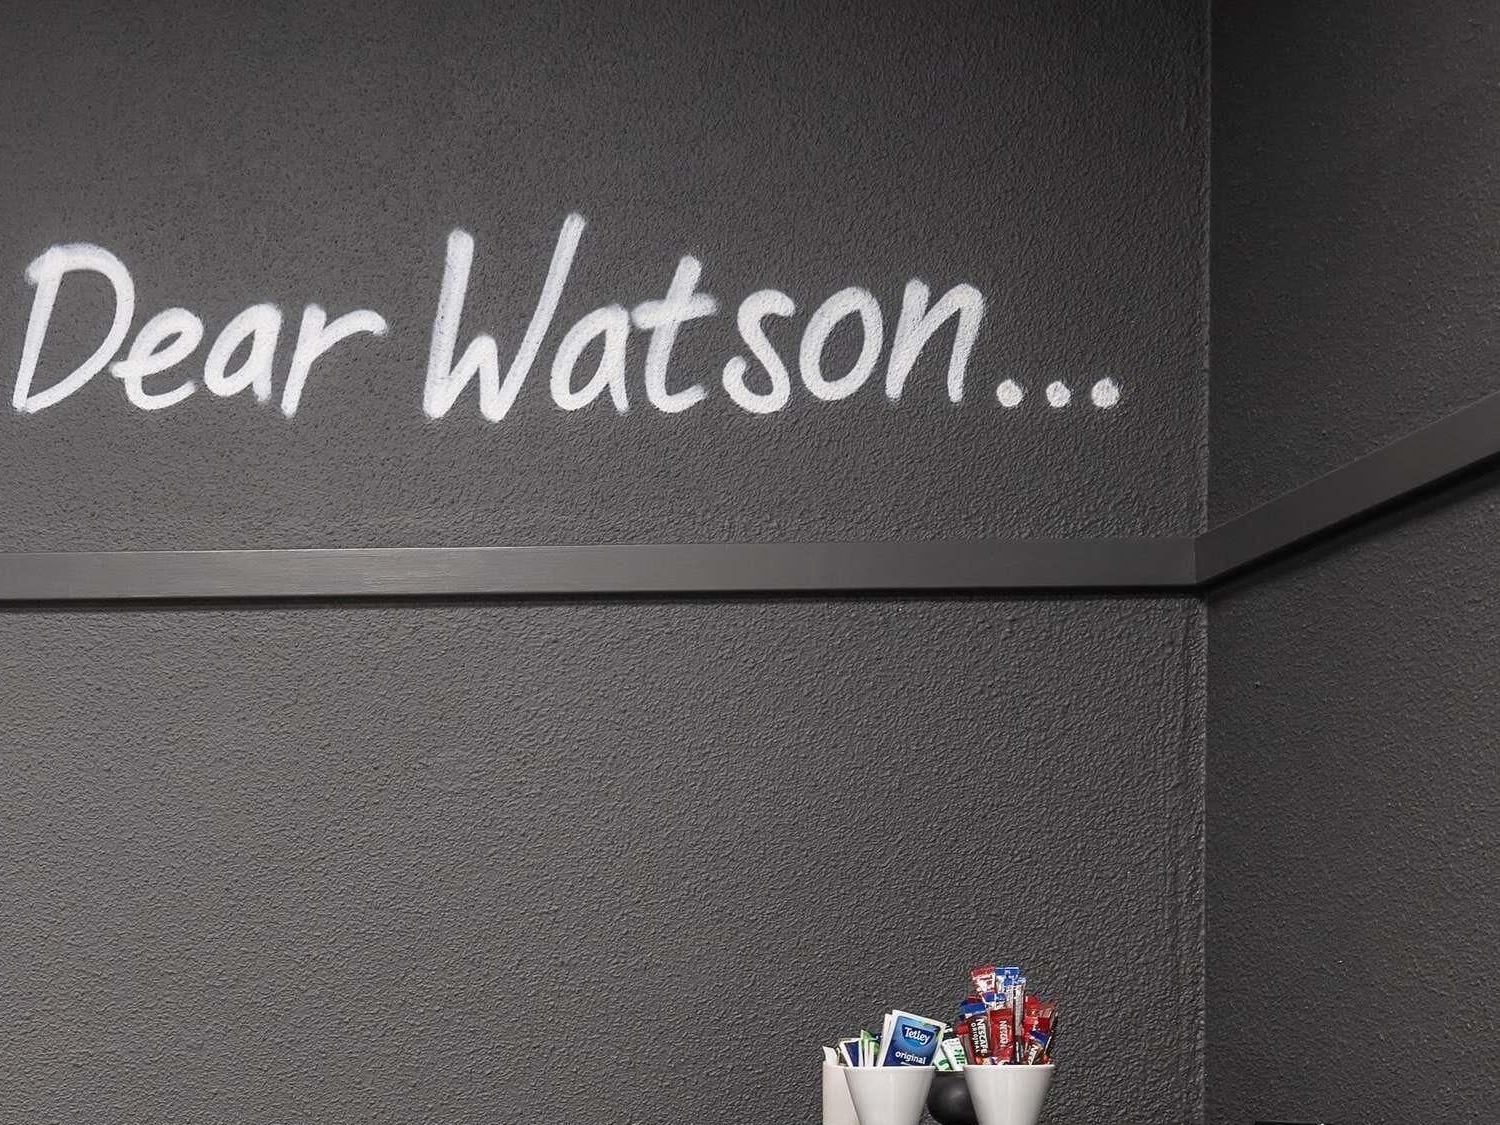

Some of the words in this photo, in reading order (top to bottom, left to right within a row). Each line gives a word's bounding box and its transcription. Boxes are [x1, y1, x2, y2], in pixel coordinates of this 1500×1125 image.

[11, 242, 390, 420] Dear
[422, 212, 1121, 424] Watson...
[904, 1026, 931, 1046] Tetley
[895, 1050, 927, 1065] original
